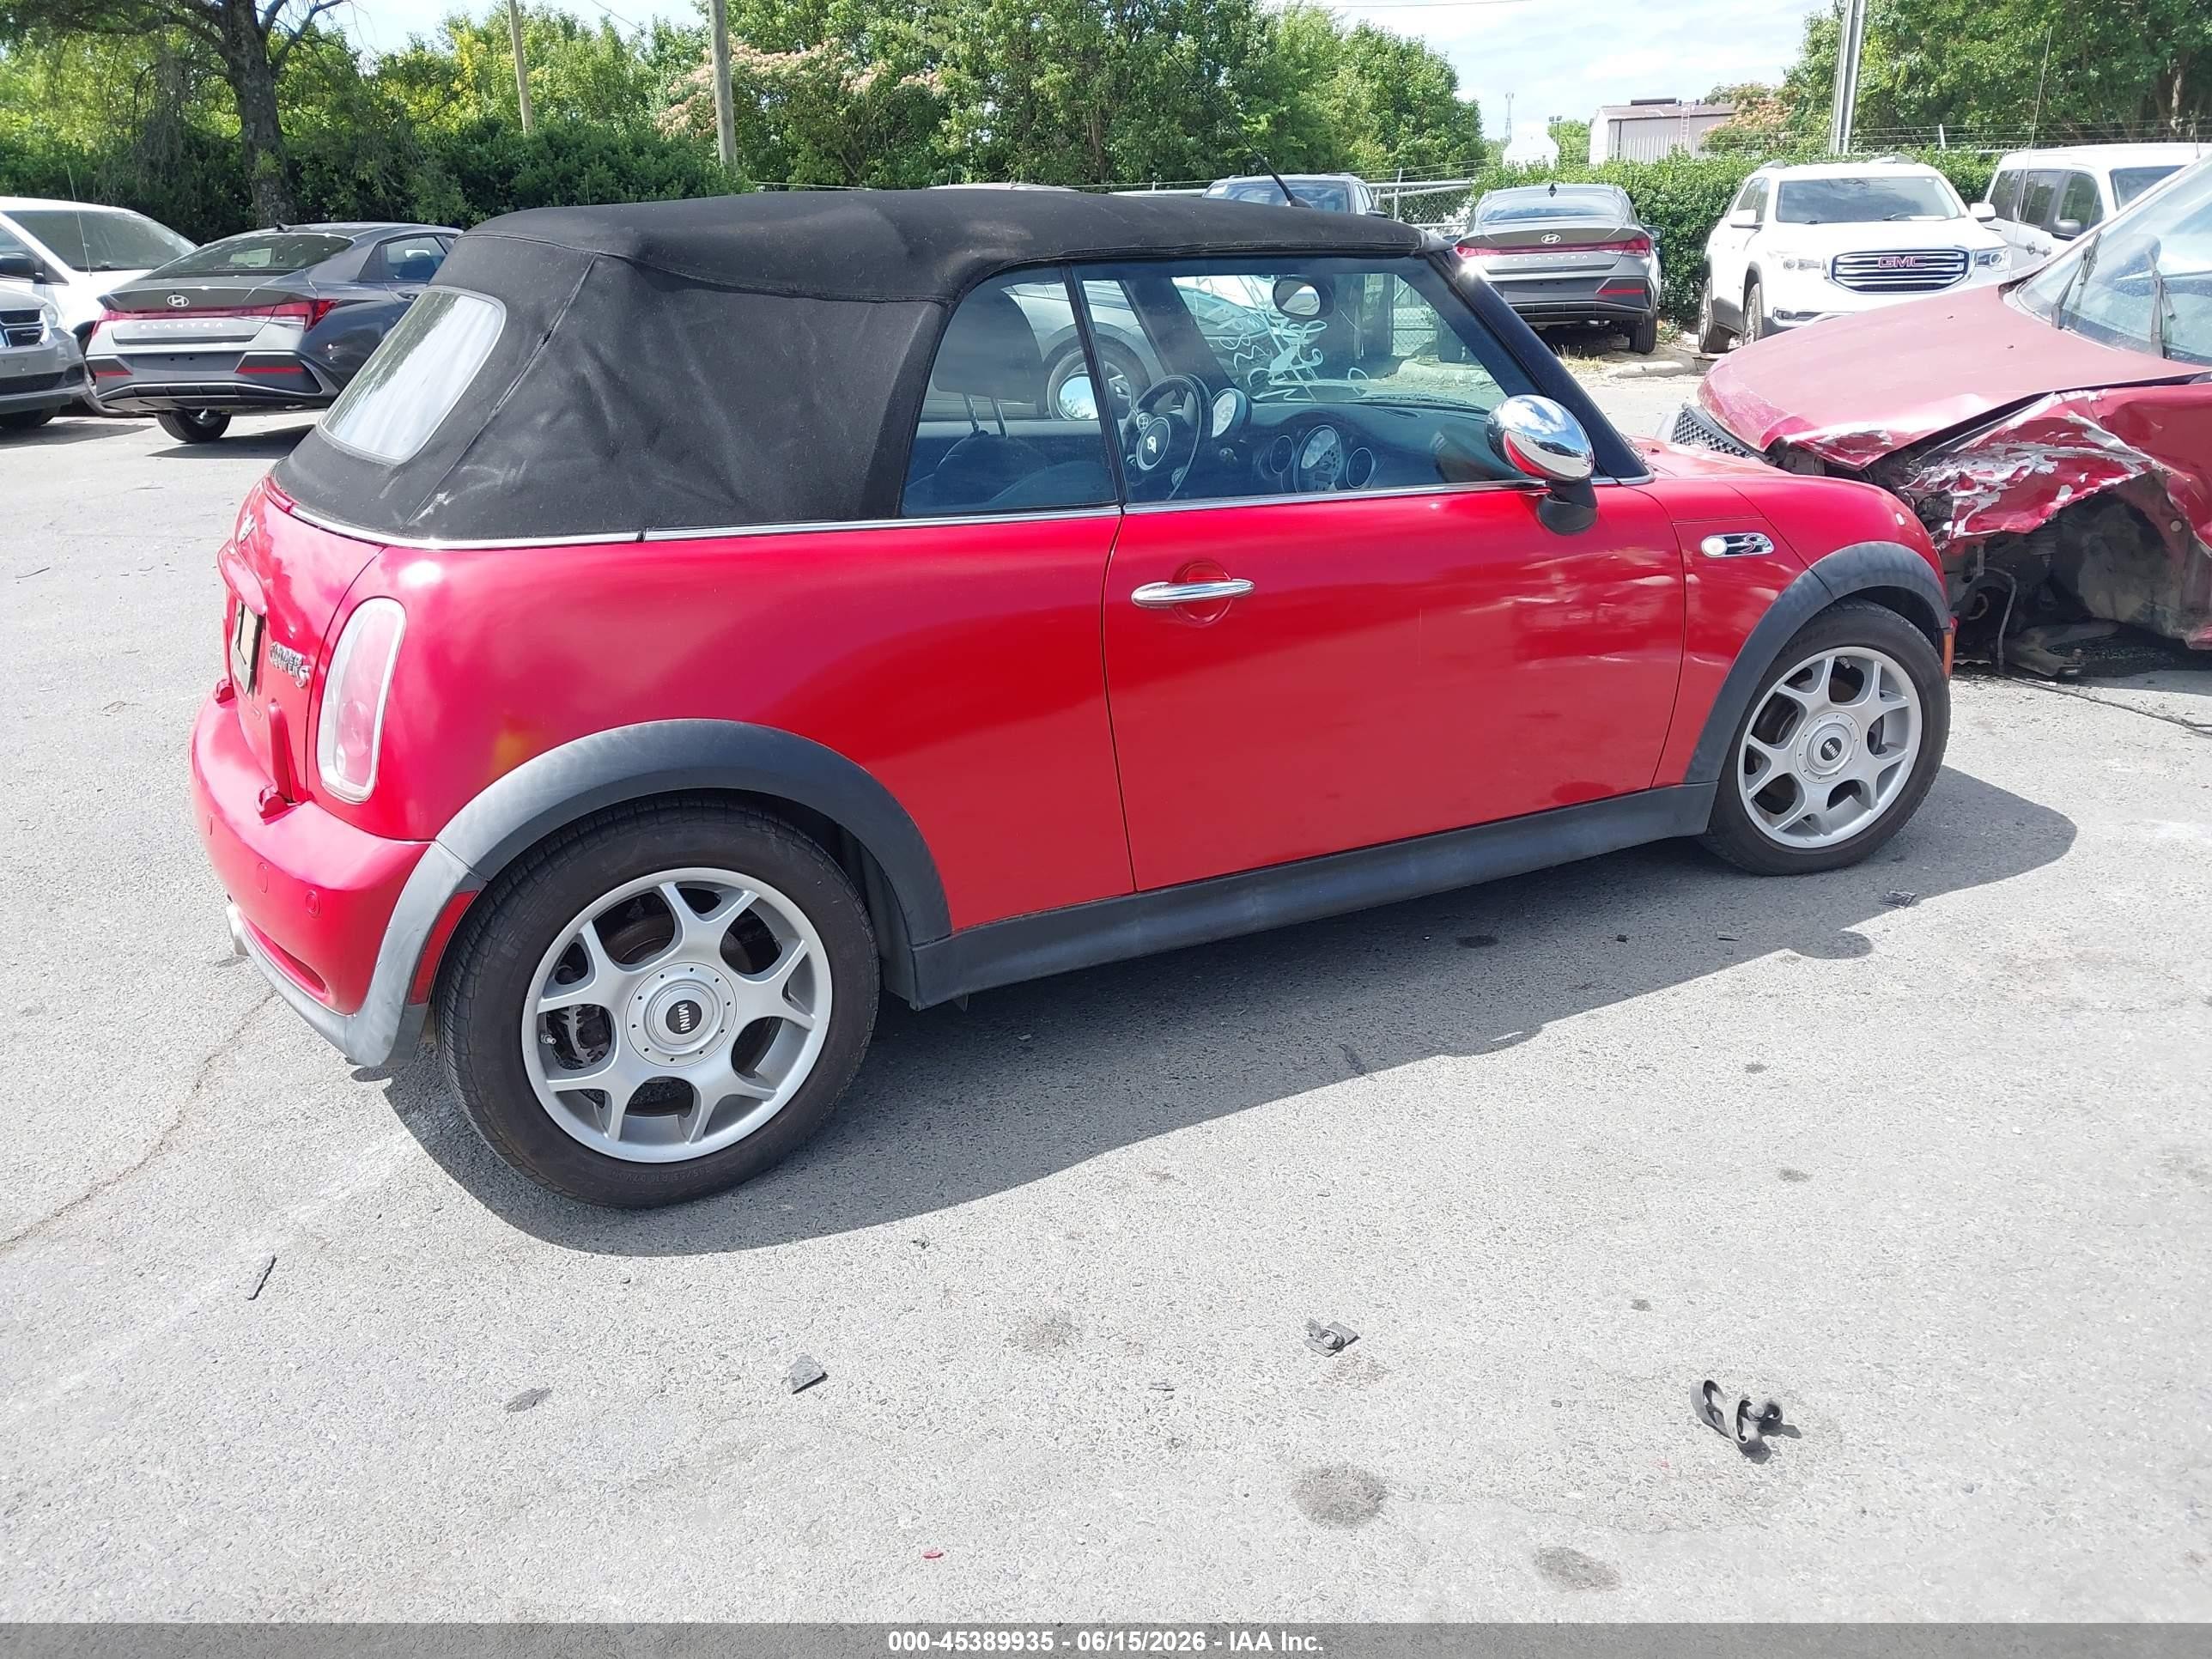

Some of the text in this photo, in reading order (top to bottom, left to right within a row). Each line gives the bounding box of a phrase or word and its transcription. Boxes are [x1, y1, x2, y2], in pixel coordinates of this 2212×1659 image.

[1878, 256, 1926, 268] GMC
[1824, 741, 1838, 758] MINI
[678, 1003, 691, 1031] MINI
